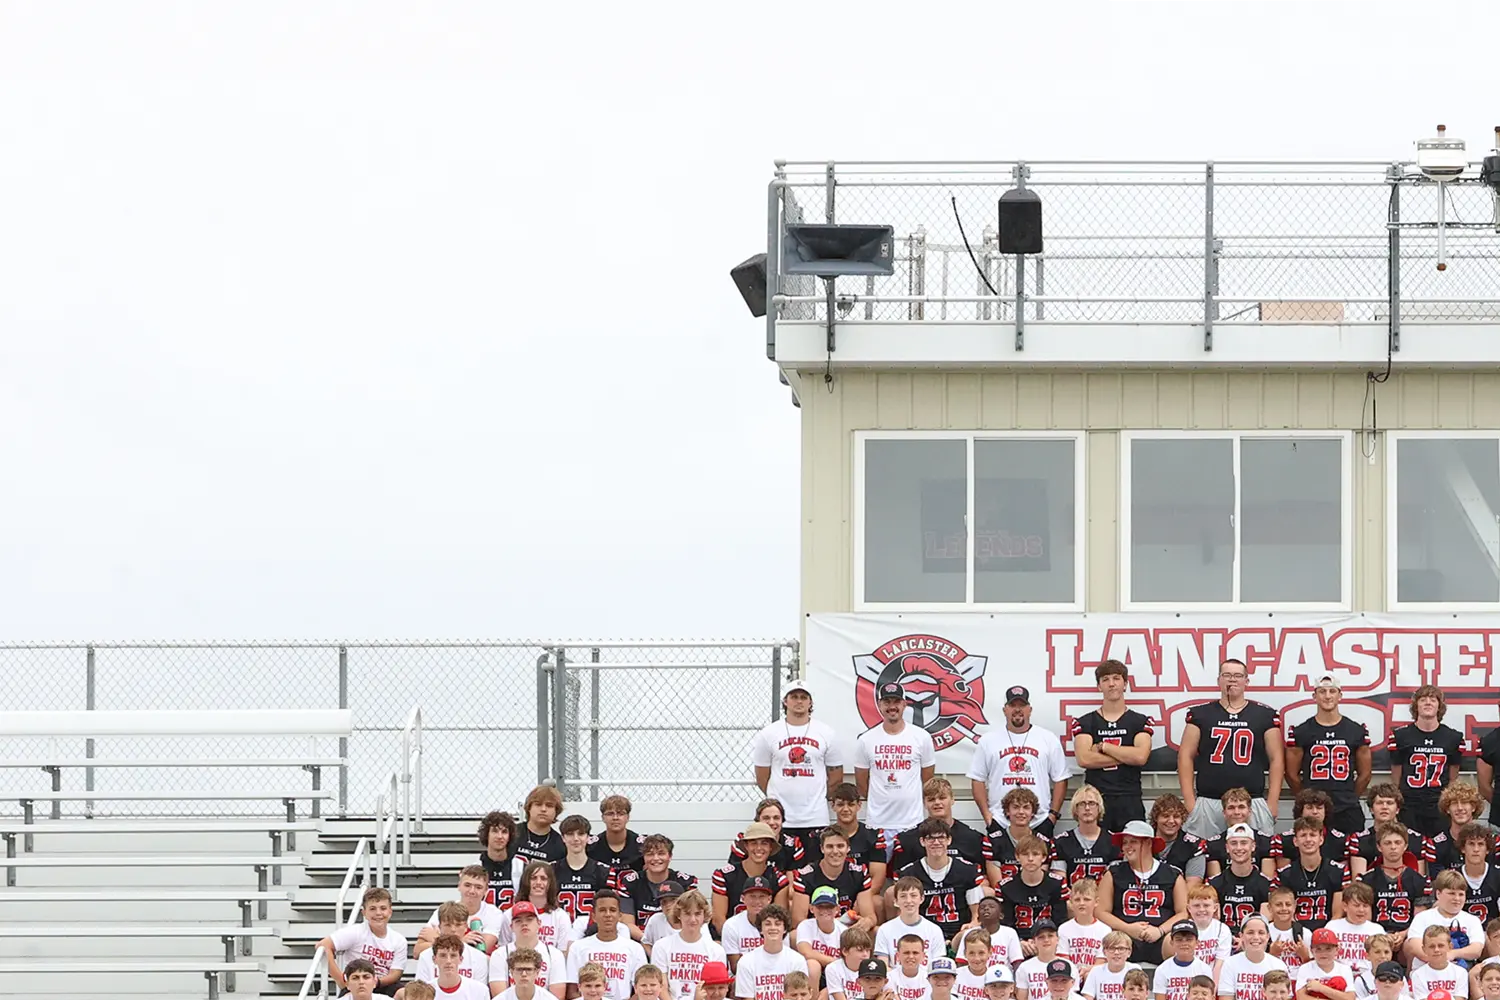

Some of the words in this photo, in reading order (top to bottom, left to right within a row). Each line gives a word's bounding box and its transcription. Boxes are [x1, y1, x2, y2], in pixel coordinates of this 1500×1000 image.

[882, 638, 959, 659] LANCASTER
[779, 737, 820, 749] LANCASTER
[1209, 727, 1254, 765] 70
[874, 745, 912, 754] LEGENDS
[999, 746, 1039, 758] LANCASTER
[875, 760, 912, 770] MAKING
[1310, 745, 1350, 781] 28
[782, 768, 814, 777] FOOTBALL
[1407, 753, 1447, 788] 37
[1002, 777, 1036, 785] FOOTBALL
[517, 847, 547, 858] LANCASTER
[1070, 864, 1106, 885] 47
[557, 890, 600, 924] 35
[926, 894, 959, 922] 41
[1122, 890, 1165, 916] 67
[1295, 896, 1327, 920] 31
[1377, 899, 1411, 922] 13
[1067, 937, 1101, 948] LEGENDS
[588, 953, 627, 963] LEGENDS
[670, 953, 708, 963] LEGENDS
[1336, 949, 1368, 960] MAKIN
[1167, 977, 1190, 988] LEGEN
[1237, 973, 1264, 983] LEGEN
[1427, 981, 1456, 990] EGENDS
